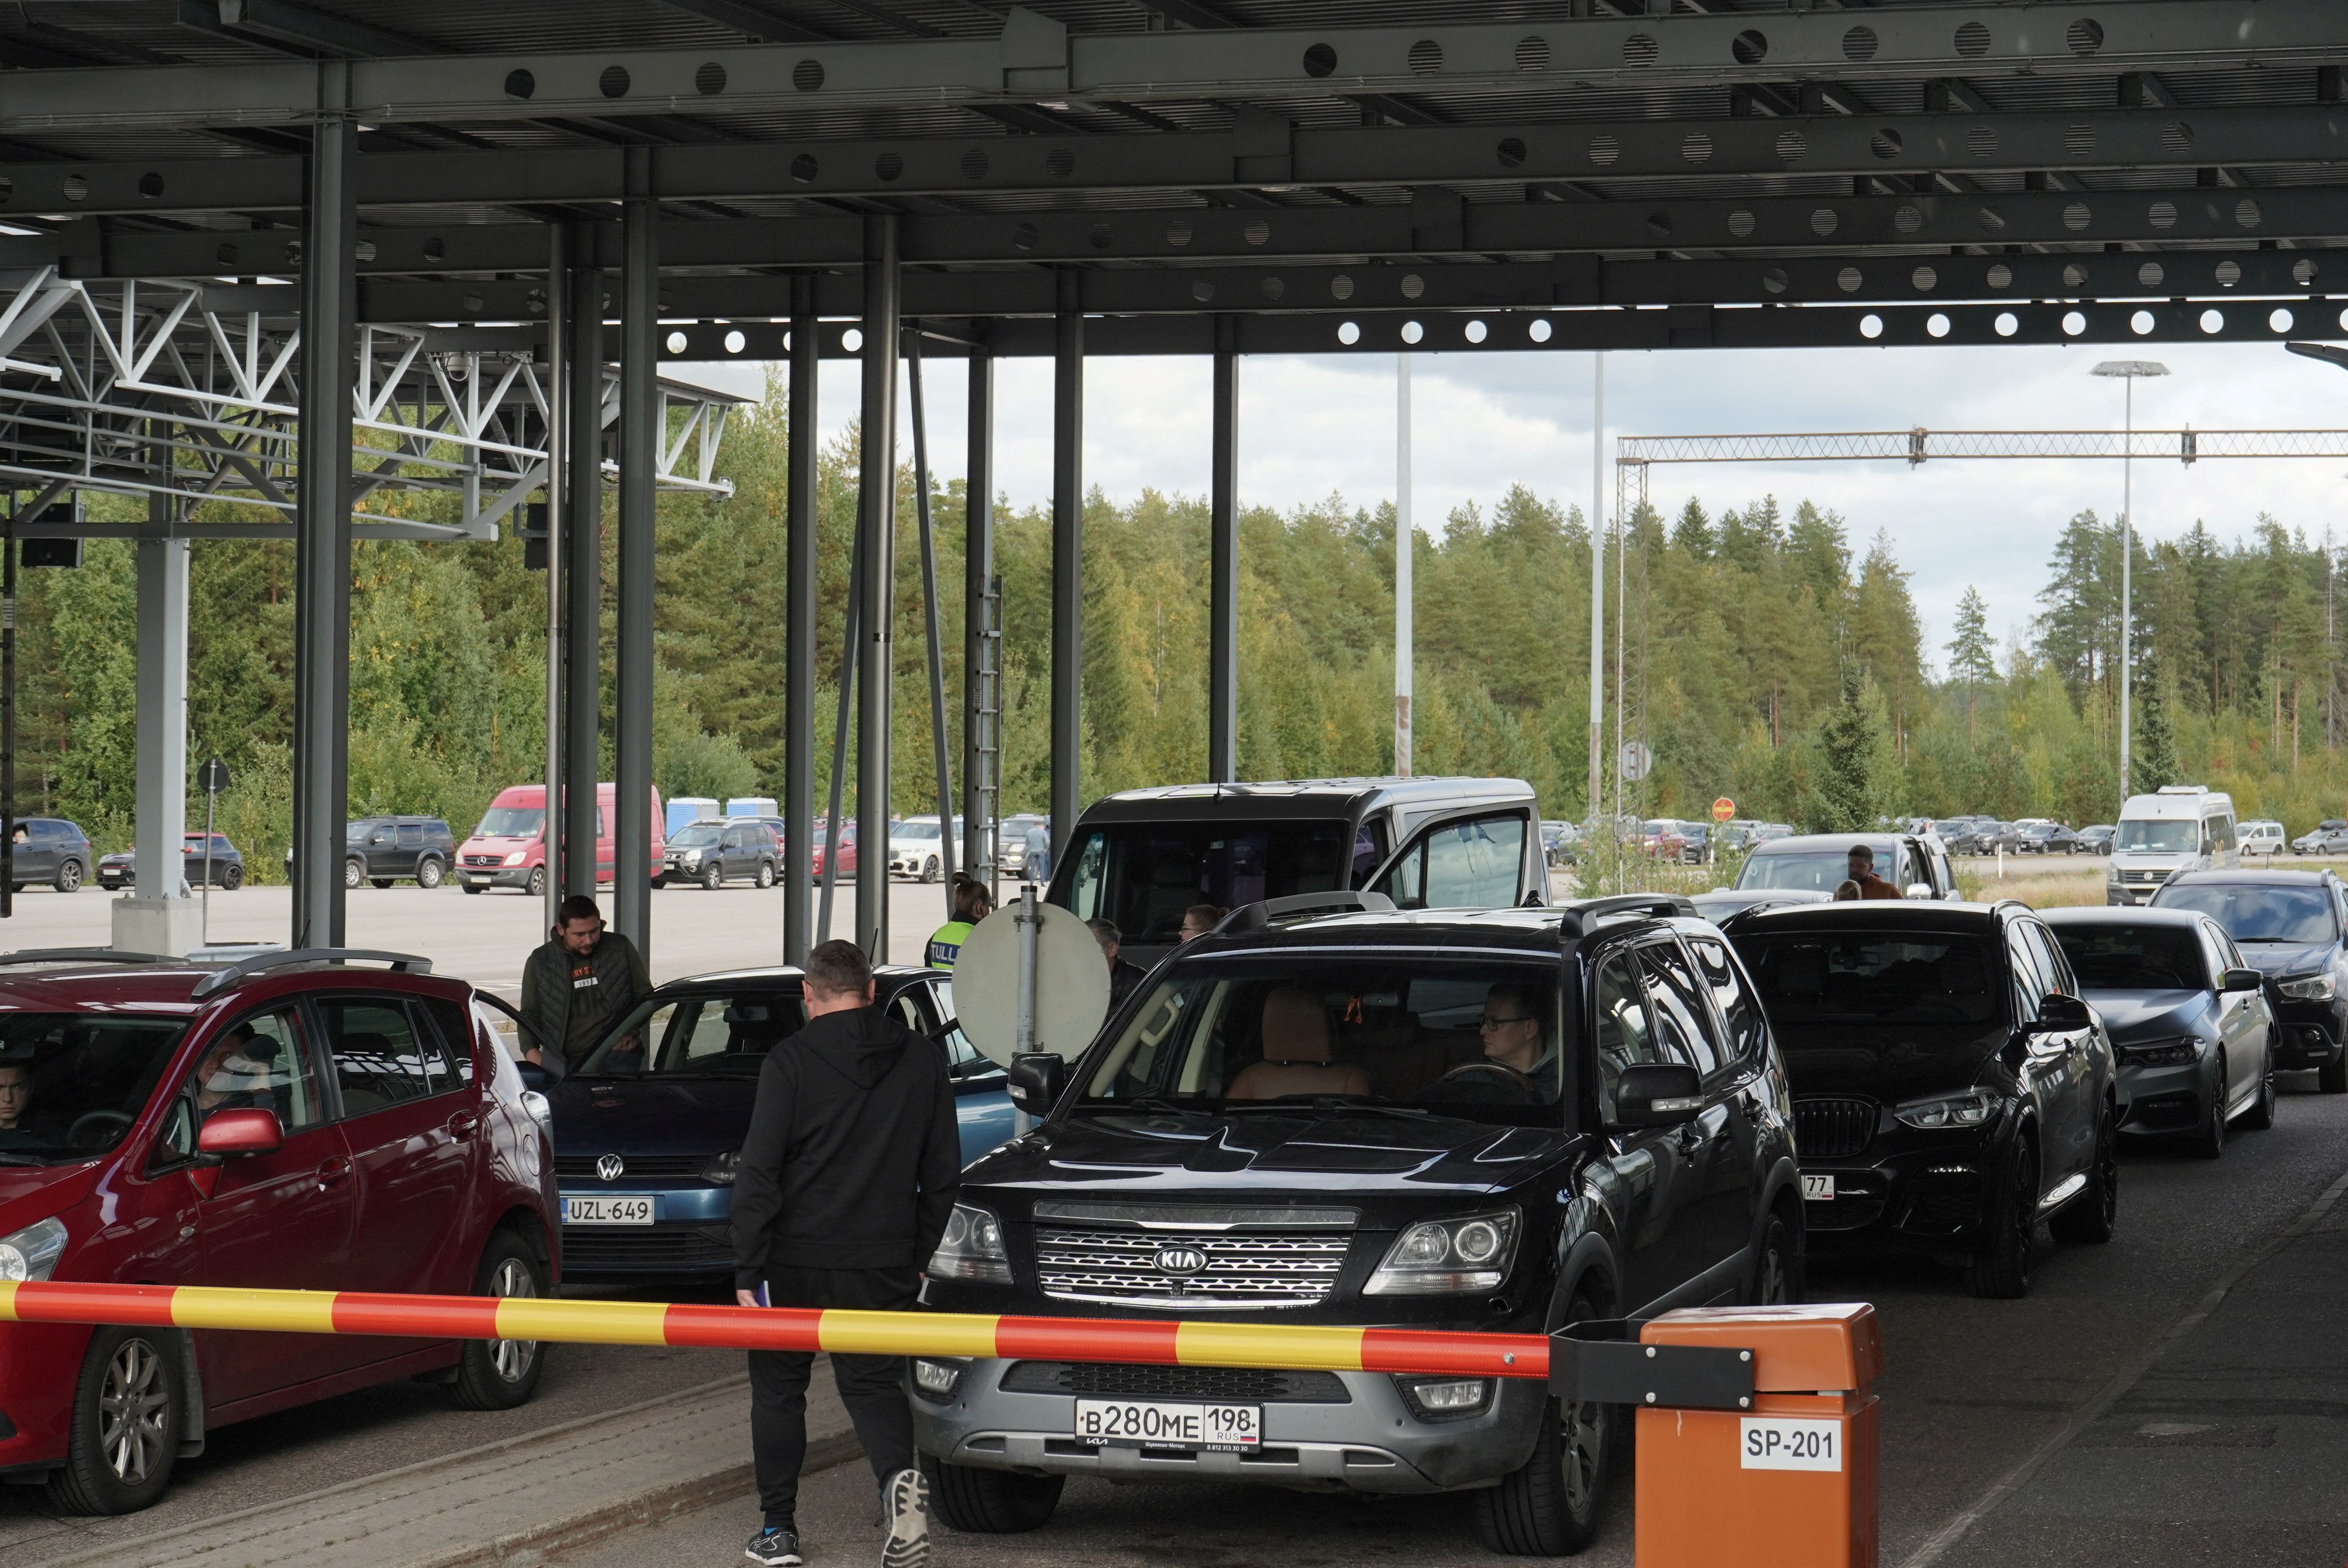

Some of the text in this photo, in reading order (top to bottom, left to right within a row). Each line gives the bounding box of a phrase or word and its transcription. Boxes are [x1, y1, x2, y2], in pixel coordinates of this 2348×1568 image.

[931, 944, 959, 962] TULL
[1807, 1177, 1826, 1192] 77
[572, 1201, 648, 1220] UZL-649
[1162, 1251, 1197, 1268] KIA
[1207, 1408, 1251, 1432] 198
[1217, 1432, 1239, 1441] RUS
[1747, 1429, 1831, 1458] SP-201
